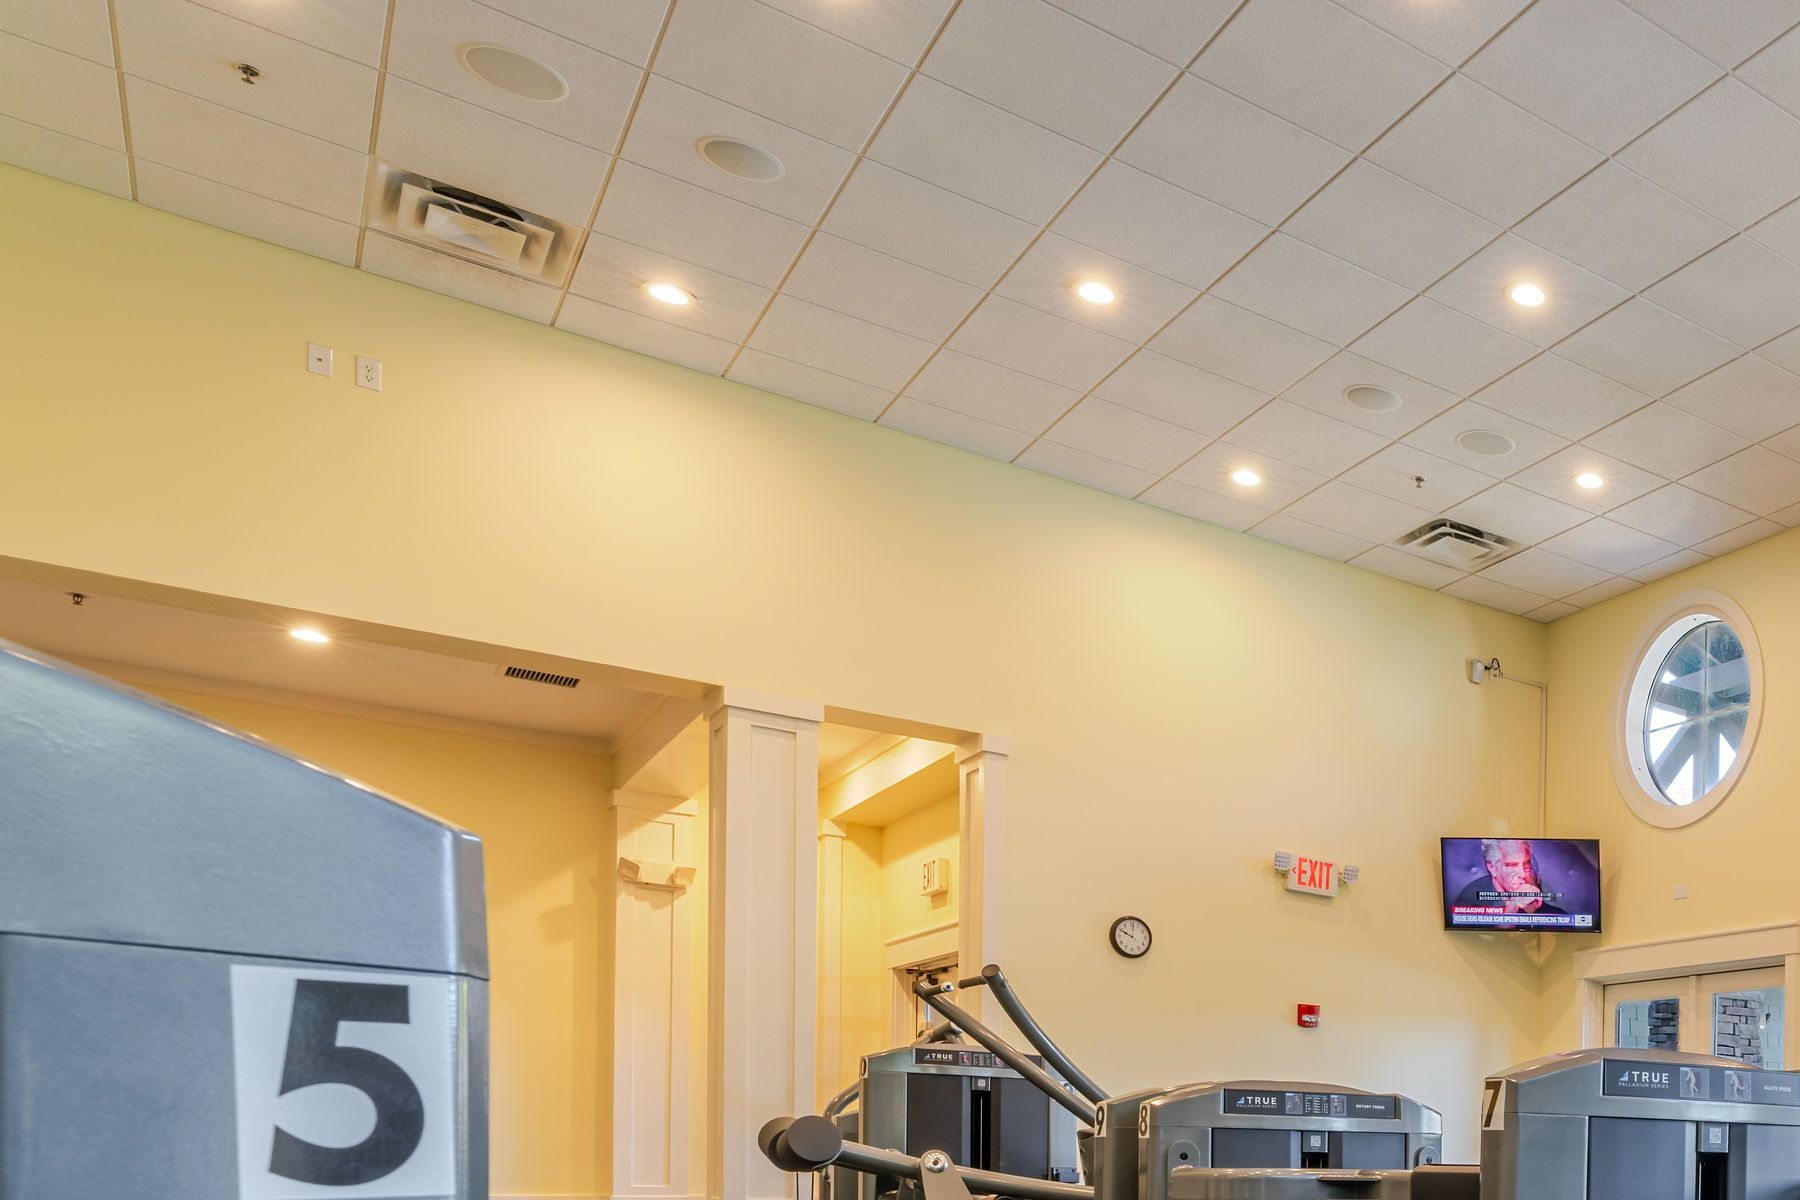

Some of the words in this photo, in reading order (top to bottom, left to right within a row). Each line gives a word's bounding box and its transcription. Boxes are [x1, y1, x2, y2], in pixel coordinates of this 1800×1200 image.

[1298, 857, 1333, 890] EXIT
[268, 979, 424, 1186] 5
[1632, 1071, 1669, 1084] TRUE
[1247, 1096, 1277, 1105] TRUE
[1483, 1081, 1502, 1128] 7
[1096, 1105, 1105, 1136] 9
[1140, 1104, 1148, 1136] 8
